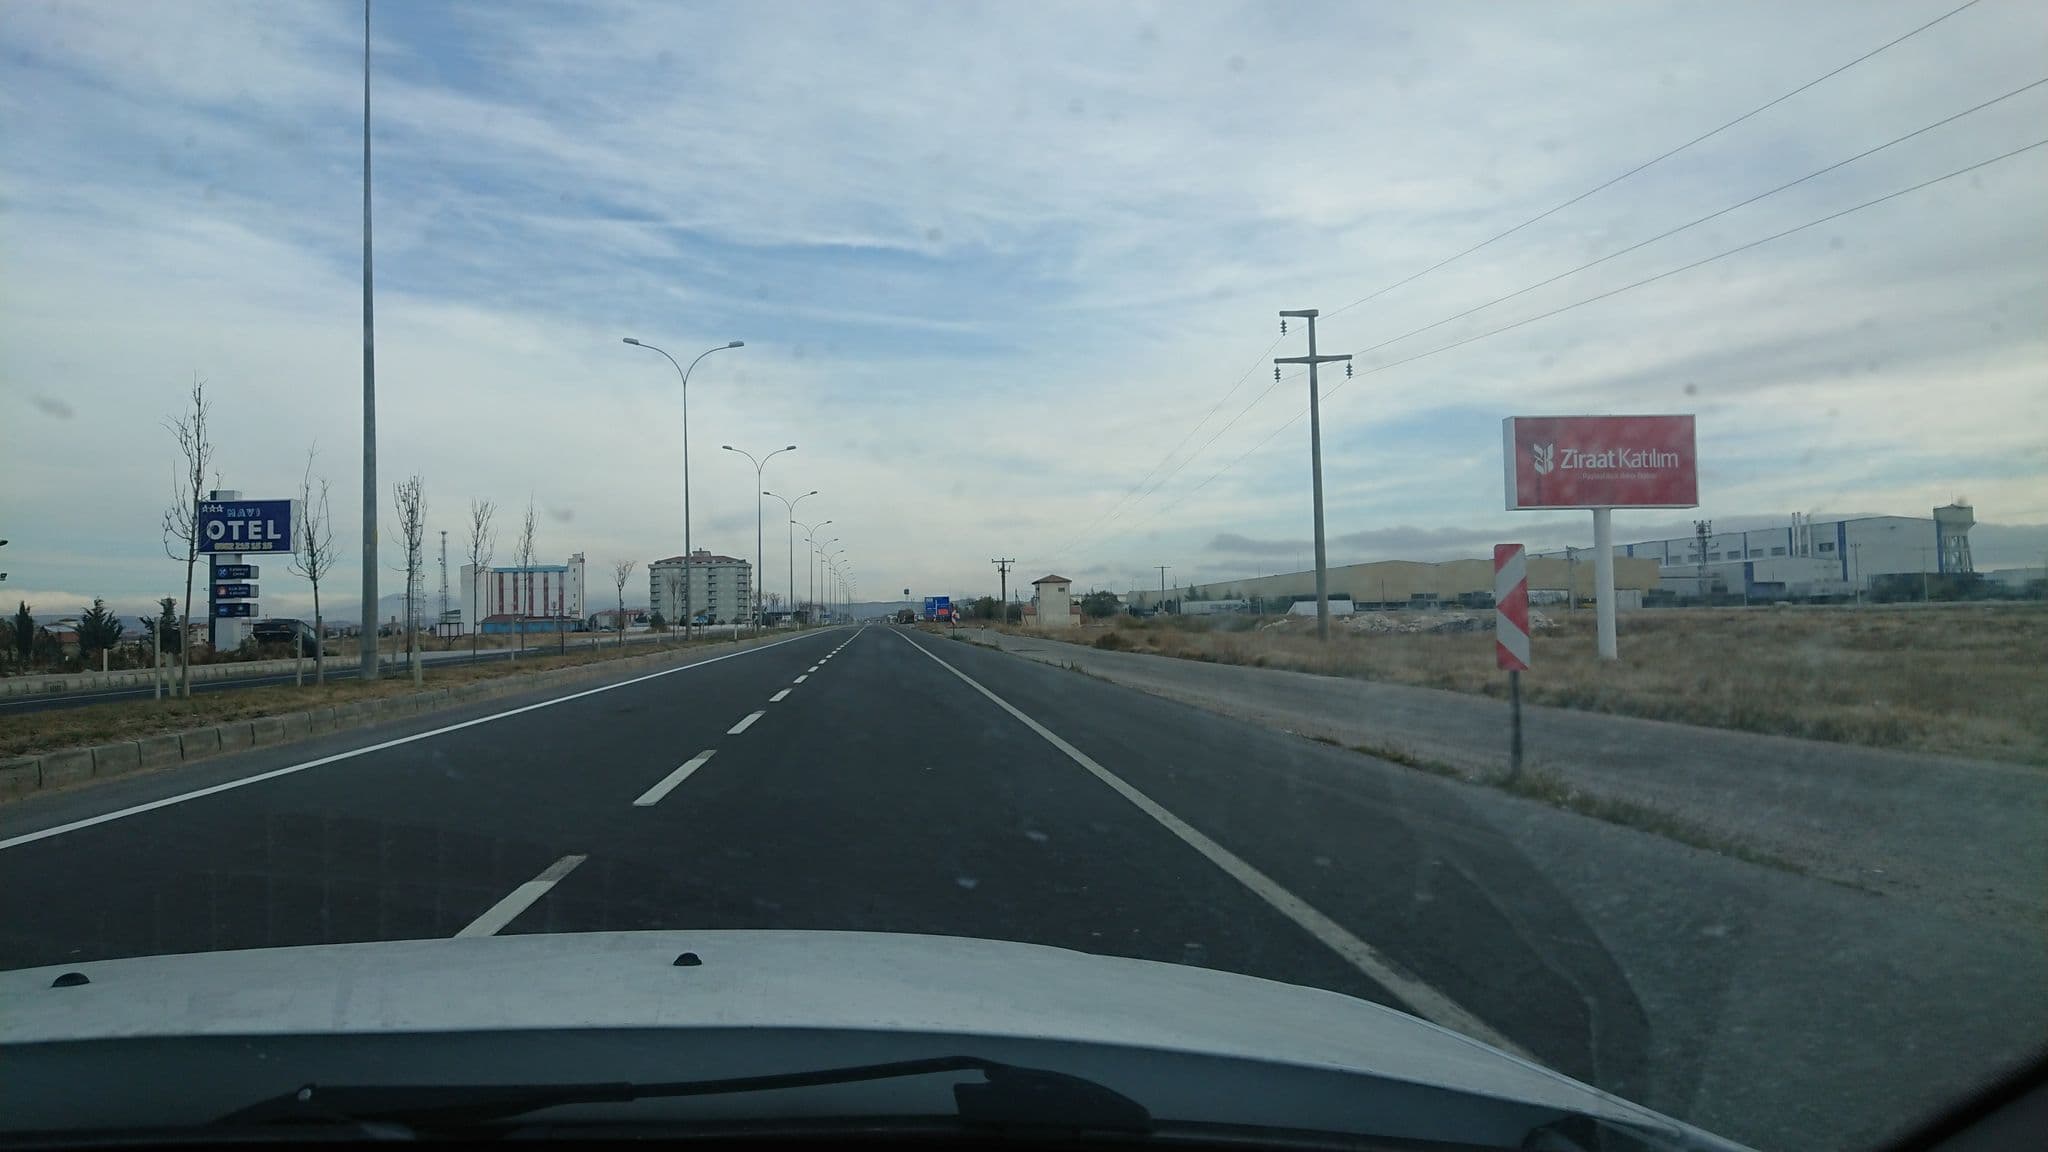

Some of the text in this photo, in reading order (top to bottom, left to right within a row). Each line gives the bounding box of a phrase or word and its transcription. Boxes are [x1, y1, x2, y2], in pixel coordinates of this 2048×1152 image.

[1560, 447, 1679, 469] Ziraat Katılım
[206, 519, 282, 540] OTEL
